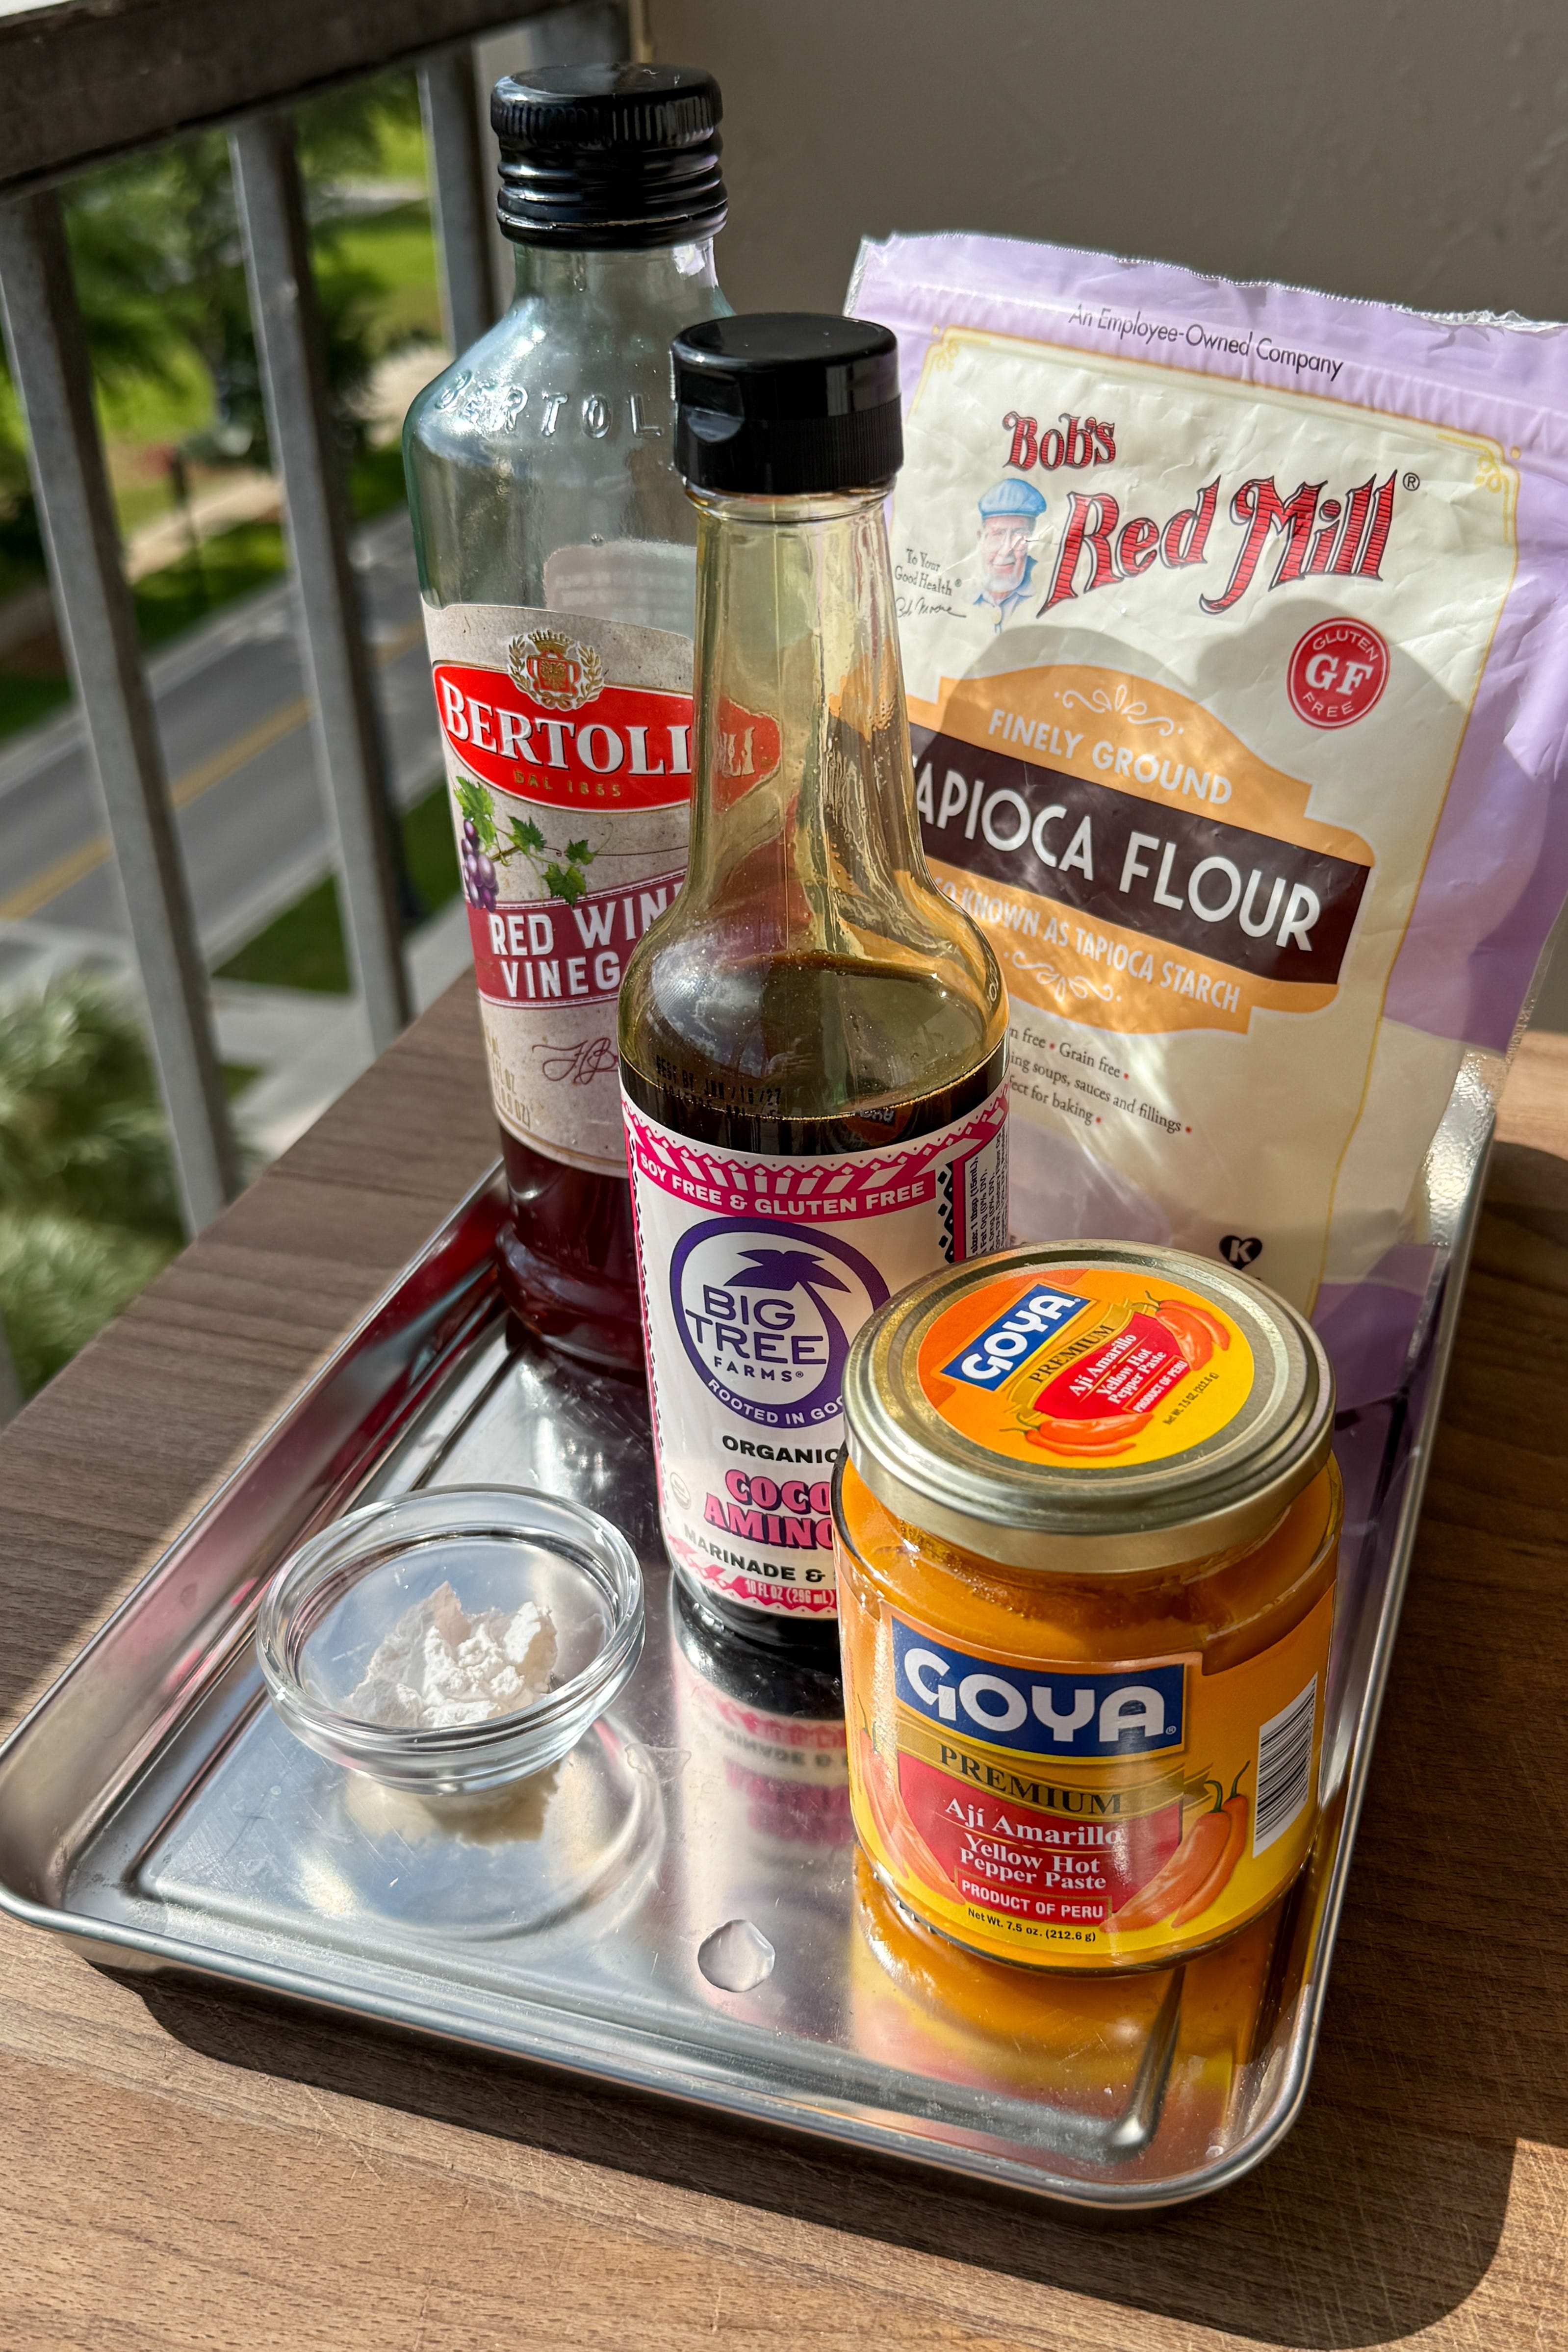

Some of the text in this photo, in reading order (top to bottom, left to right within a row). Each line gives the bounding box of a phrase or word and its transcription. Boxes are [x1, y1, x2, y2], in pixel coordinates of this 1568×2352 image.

[1068, 304, 1344, 381] An Employee-Owned Company
[1002, 411, 1116, 471] Bob's
[906, 548, 940, 571] To Your
[1036, 469, 1398, 619] Red Mill
[895, 565, 952, 596] Good Health
[1312, 630, 1379, 662] GLUTEN
[1305, 653, 1374, 696] GF
[1302, 691, 1354, 717] FREE
[514, 769, 553, 790] DAL
[987, 709, 1232, 805] FINELY GROUND
[913, 754, 1321, 952] APIOCA FLOUR
[488, 882, 684, 956] RED WIN
[961, 886, 1041, 937] KNOWN
[1043, 917, 1069, 947] AS
[1076, 927, 1154, 982] TAPIOCA
[1160, 960, 1241, 1013] STARCH
[1023, 1028, 1046, 1049] free
[1060, 1042, 1095, 1067] Grain
[1098, 1057, 1121, 1078] free
[1031, 1085, 1049, 1103] for
[1052, 1092, 1094, 1126] baking
[1032, 1063, 1071, 1086] soups,
[1074, 1078, 1110, 1102] sauces
[1113, 1099, 1136, 1113] and
[1139, 1104, 1182, 1134] fillings
[640, 1152, 925, 1215] SOY FREE & GLUTEN FREE
[703, 1284, 795, 1330] BIG
[685, 1309, 827, 1365] TREE
[961, 1295, 1076, 1380] GOYA
[1028, 1324, 1116, 1383] PREMIUM
[1086, 1334, 1137, 1378] Amarillo
[714, 1355, 793, 1382] FARMS
[1096, 1348, 1153, 1396] Yellow Hot
[1107, 1351, 1167, 1404] Pepper Paste
[1132, 1360, 1188, 1413] PRODUCT OF PERU
[708, 1379, 779, 1423] ROOTED
[785, 1411, 805, 1424] IN
[722, 1435, 838, 1463] ORGANIC
[683, 1523, 826, 1582] MARINADE &
[745, 1579, 835, 1606] 10 FL OZ (296 mL)
[904, 1647, 1164, 1743] GOYA
[939, 1742, 1122, 1815] PREMIUM
[945, 1797, 1123, 1846] Ají Amarillo
[959, 1847, 1107, 1889] Pepper Paste
[964, 1832, 1101, 1874] Yellow Hot
[962, 1879, 1104, 1918] PRODUCT OF PERU
[968, 1907, 1096, 1942] Net Wt. 7.5 oz. (212.6 g)
